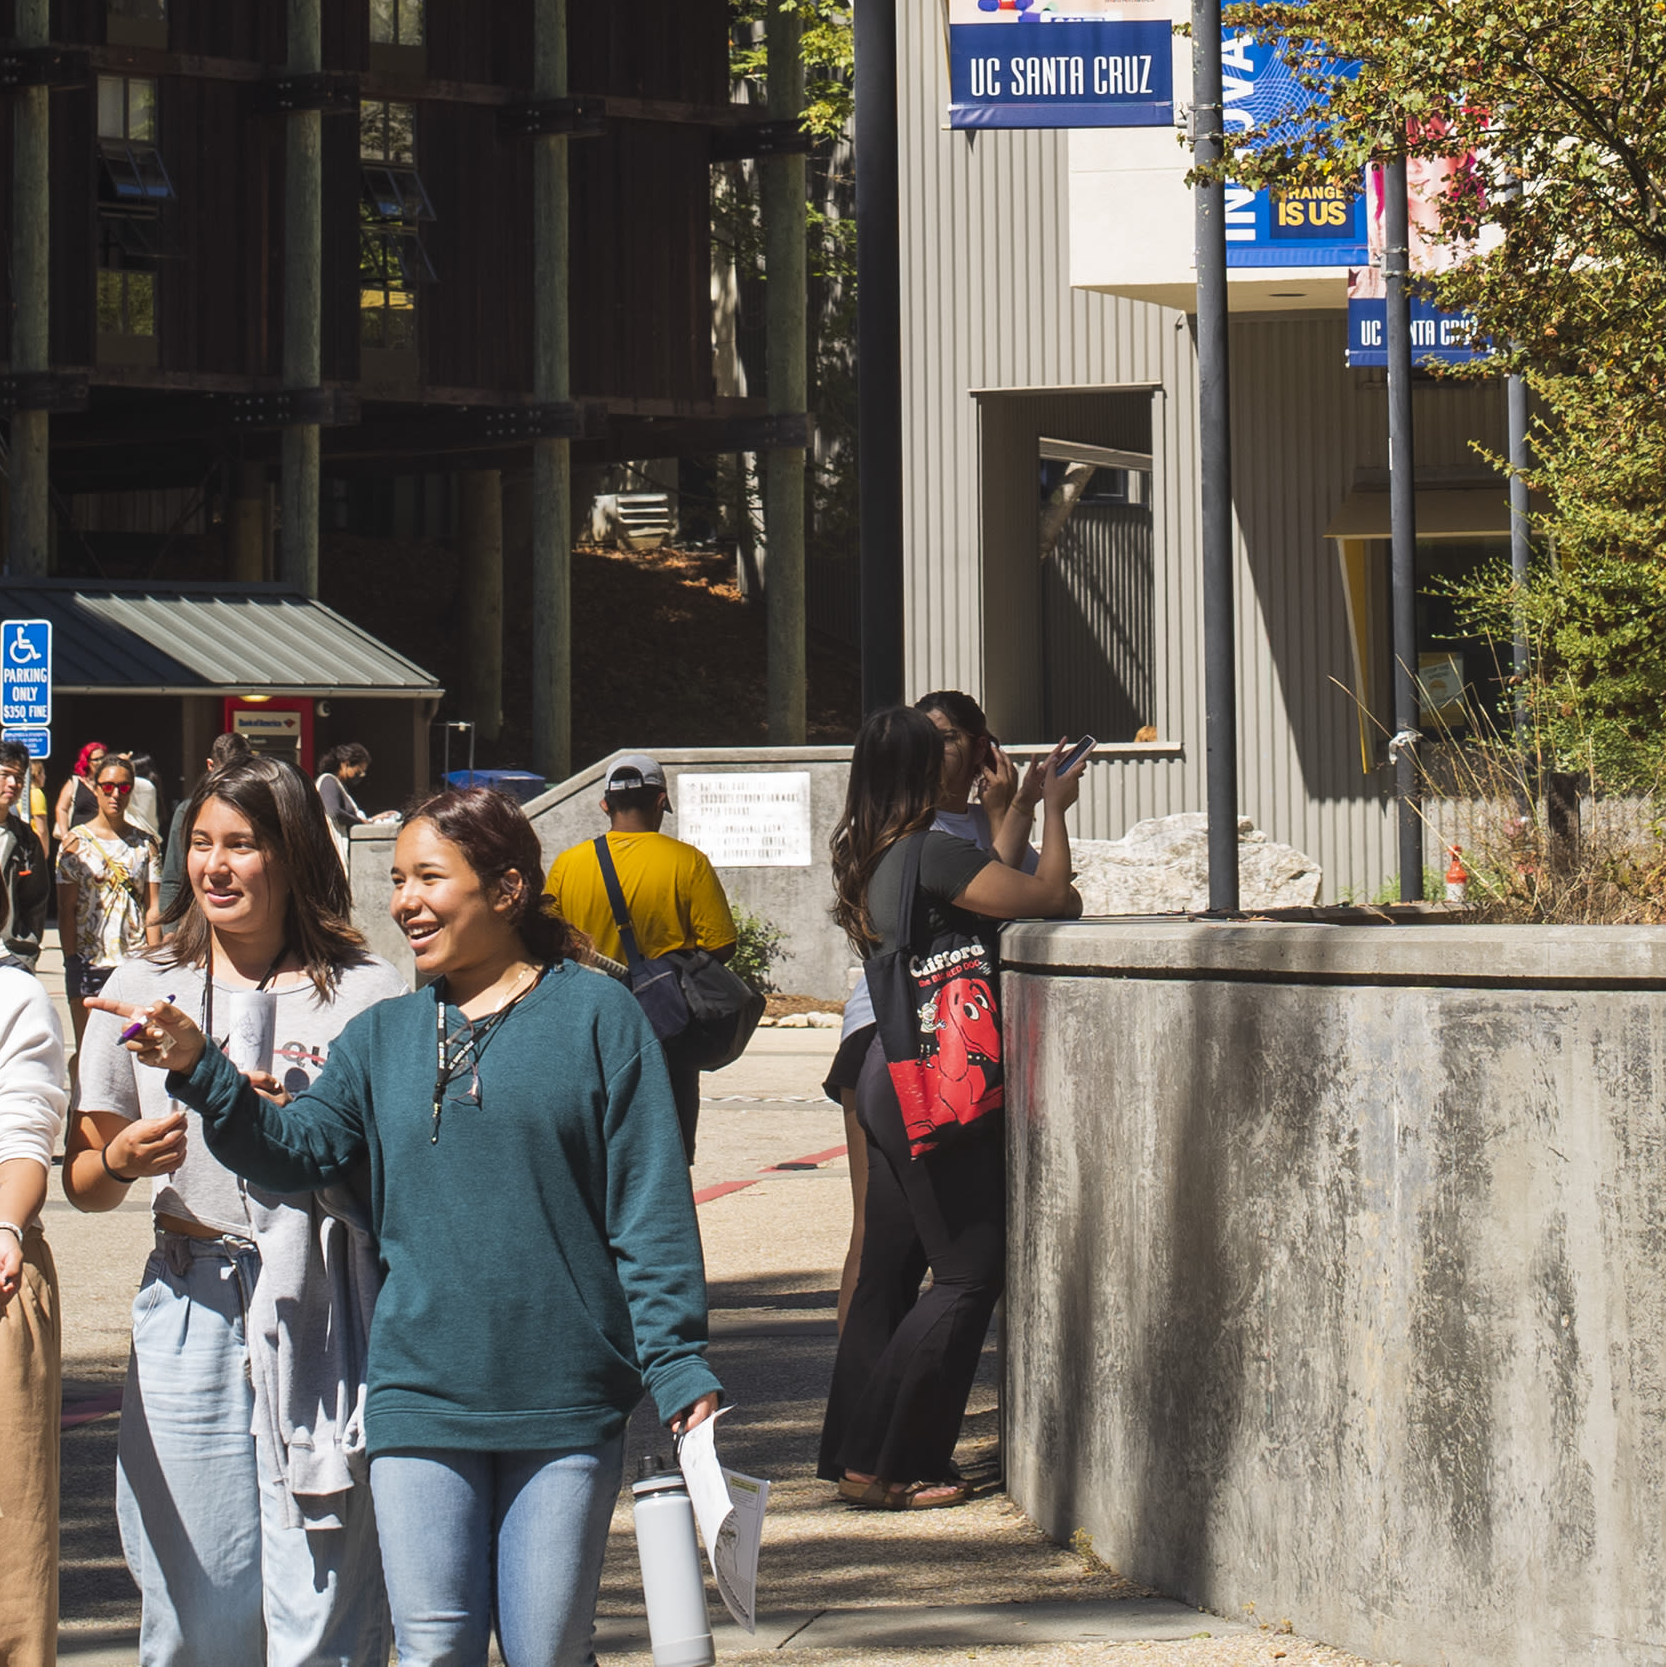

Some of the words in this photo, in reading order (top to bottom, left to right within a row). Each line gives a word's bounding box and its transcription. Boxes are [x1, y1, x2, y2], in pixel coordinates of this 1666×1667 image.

[970, 57, 1001, 97] UC
[1010, 56, 1085, 96] SANTA
[1093, 55, 1153, 95] CRUZ
[1278, 201, 1305, 227] IS
[1309, 200, 1347, 227] US
[1361, 320, 1382, 346] UC
[1410, 319, 1436, 346] NTA
[3, 667, 48, 683] PARKING
[12, 686, 38, 702] ONLY
[3, 704, 27, 719] $350
[28, 705, 48, 718] FINE
[908, 935, 986, 978] Clifford
[945, 965, 963, 978] RED
